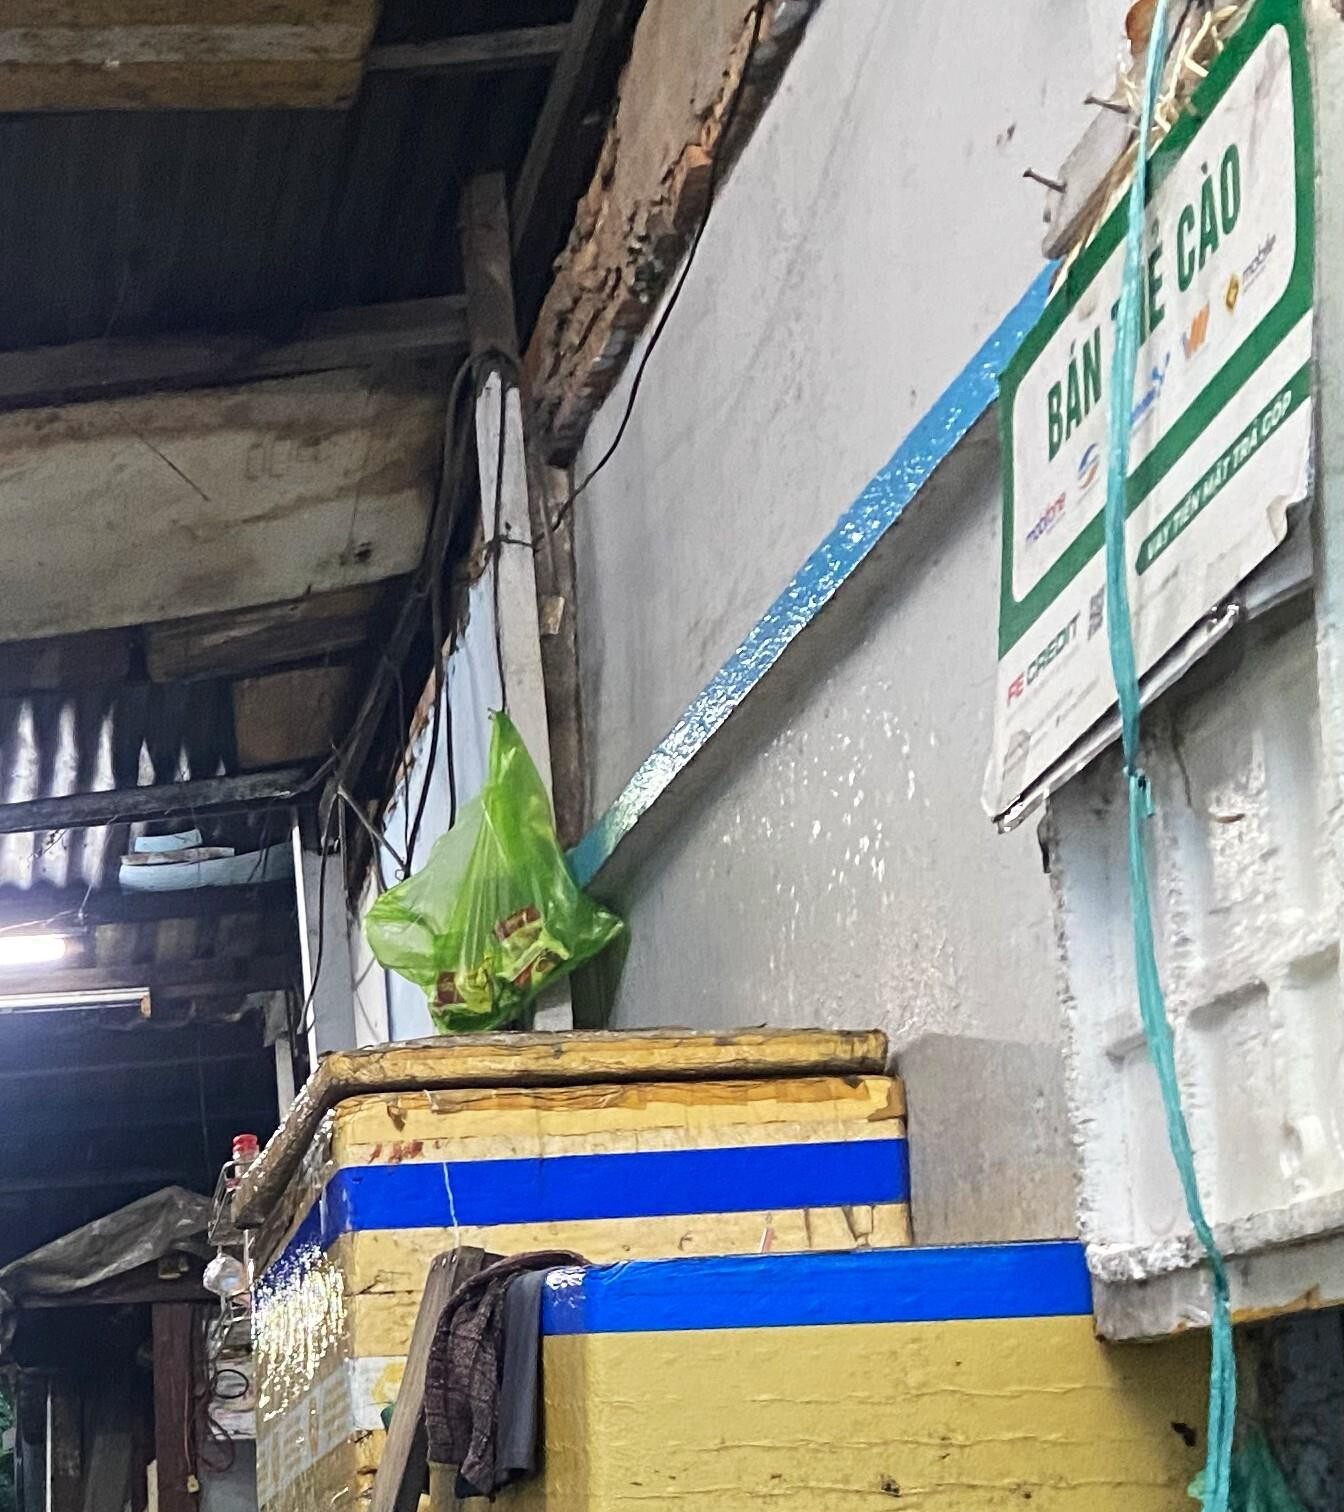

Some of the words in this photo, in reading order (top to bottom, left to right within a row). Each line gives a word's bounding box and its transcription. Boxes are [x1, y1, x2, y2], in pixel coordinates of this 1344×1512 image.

[1047, 326, 1102, 463] BÁN
[1176, 143, 1241, 292] CÀO
[1025, 612, 1081, 686] CREDIT
